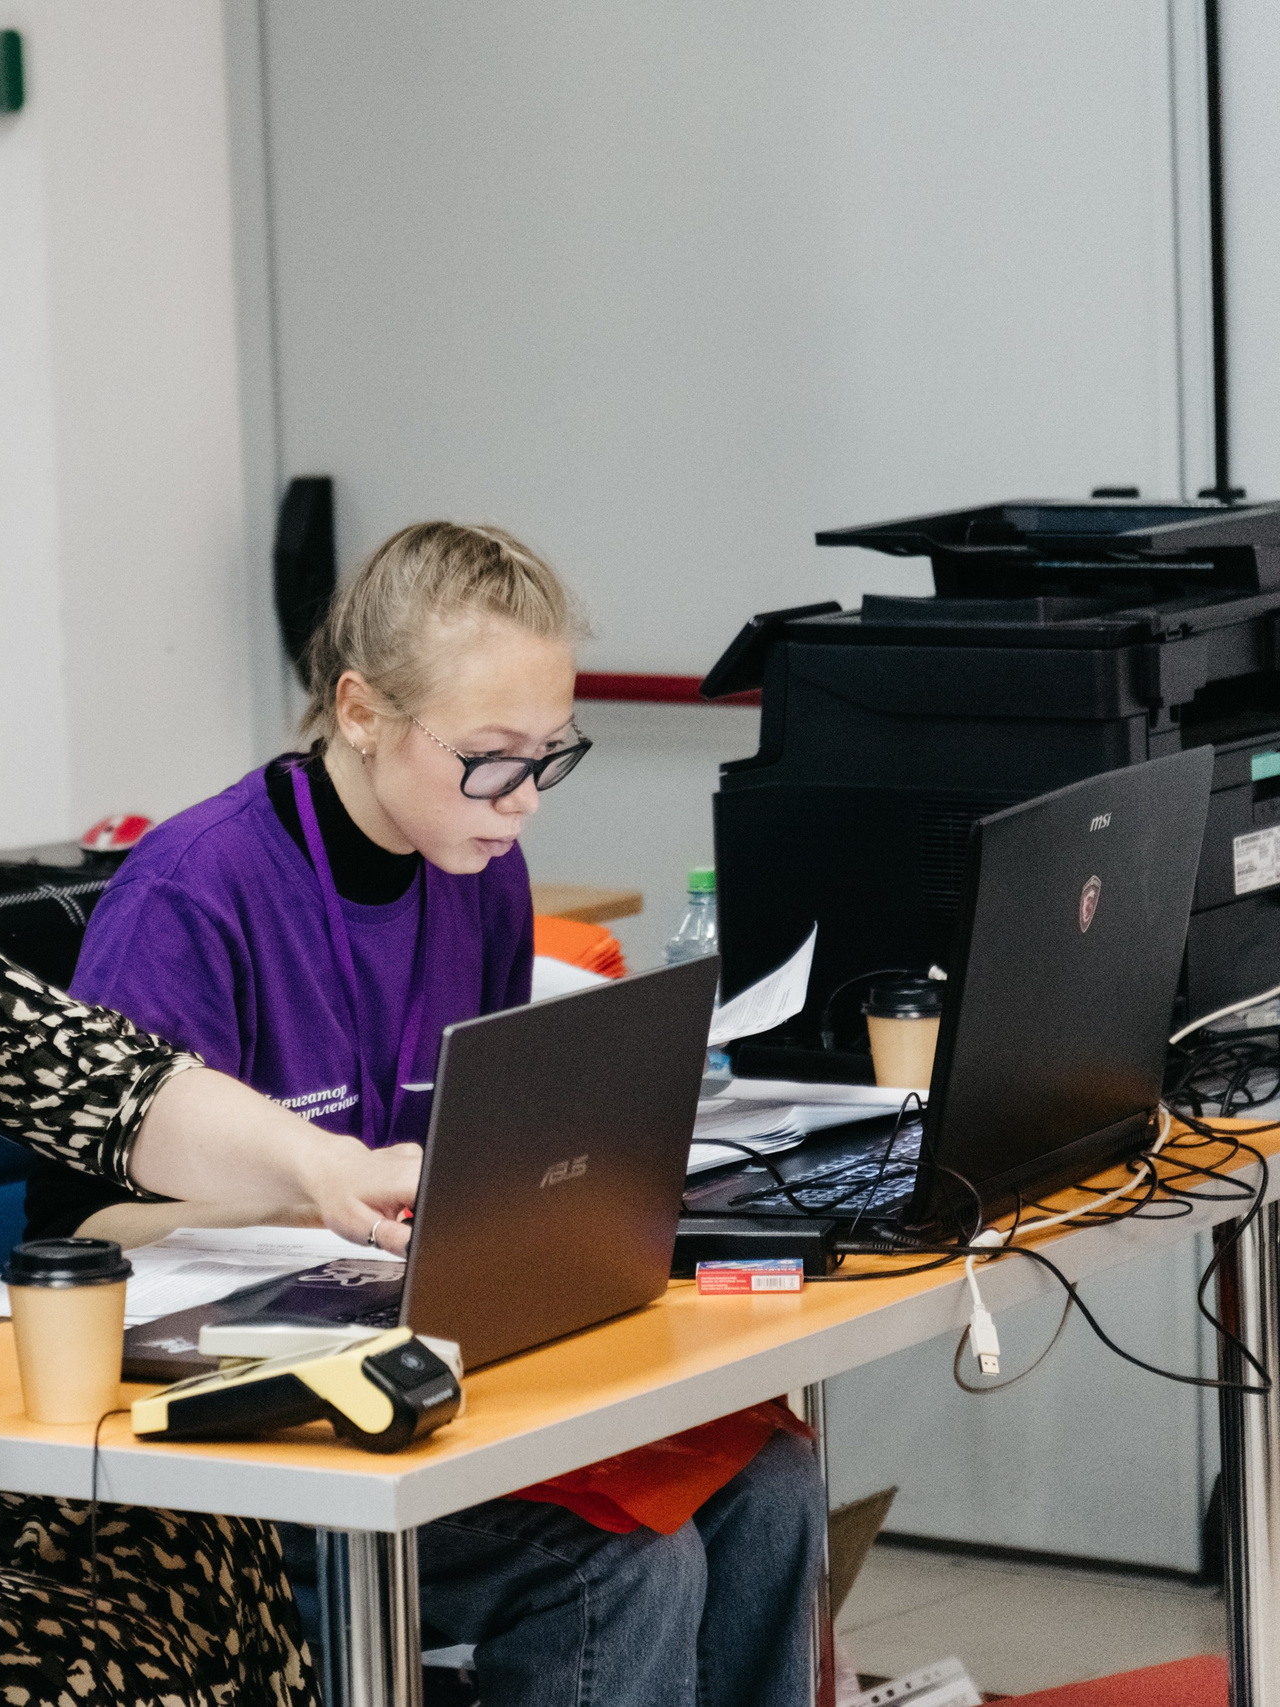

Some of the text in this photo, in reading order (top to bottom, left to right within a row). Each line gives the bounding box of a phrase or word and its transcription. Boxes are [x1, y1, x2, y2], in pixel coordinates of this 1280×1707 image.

[265, 1085, 347, 1109] авигатор
[296, 1095, 359, 1122] упления
[539, 1154, 589, 1189] ASUS
